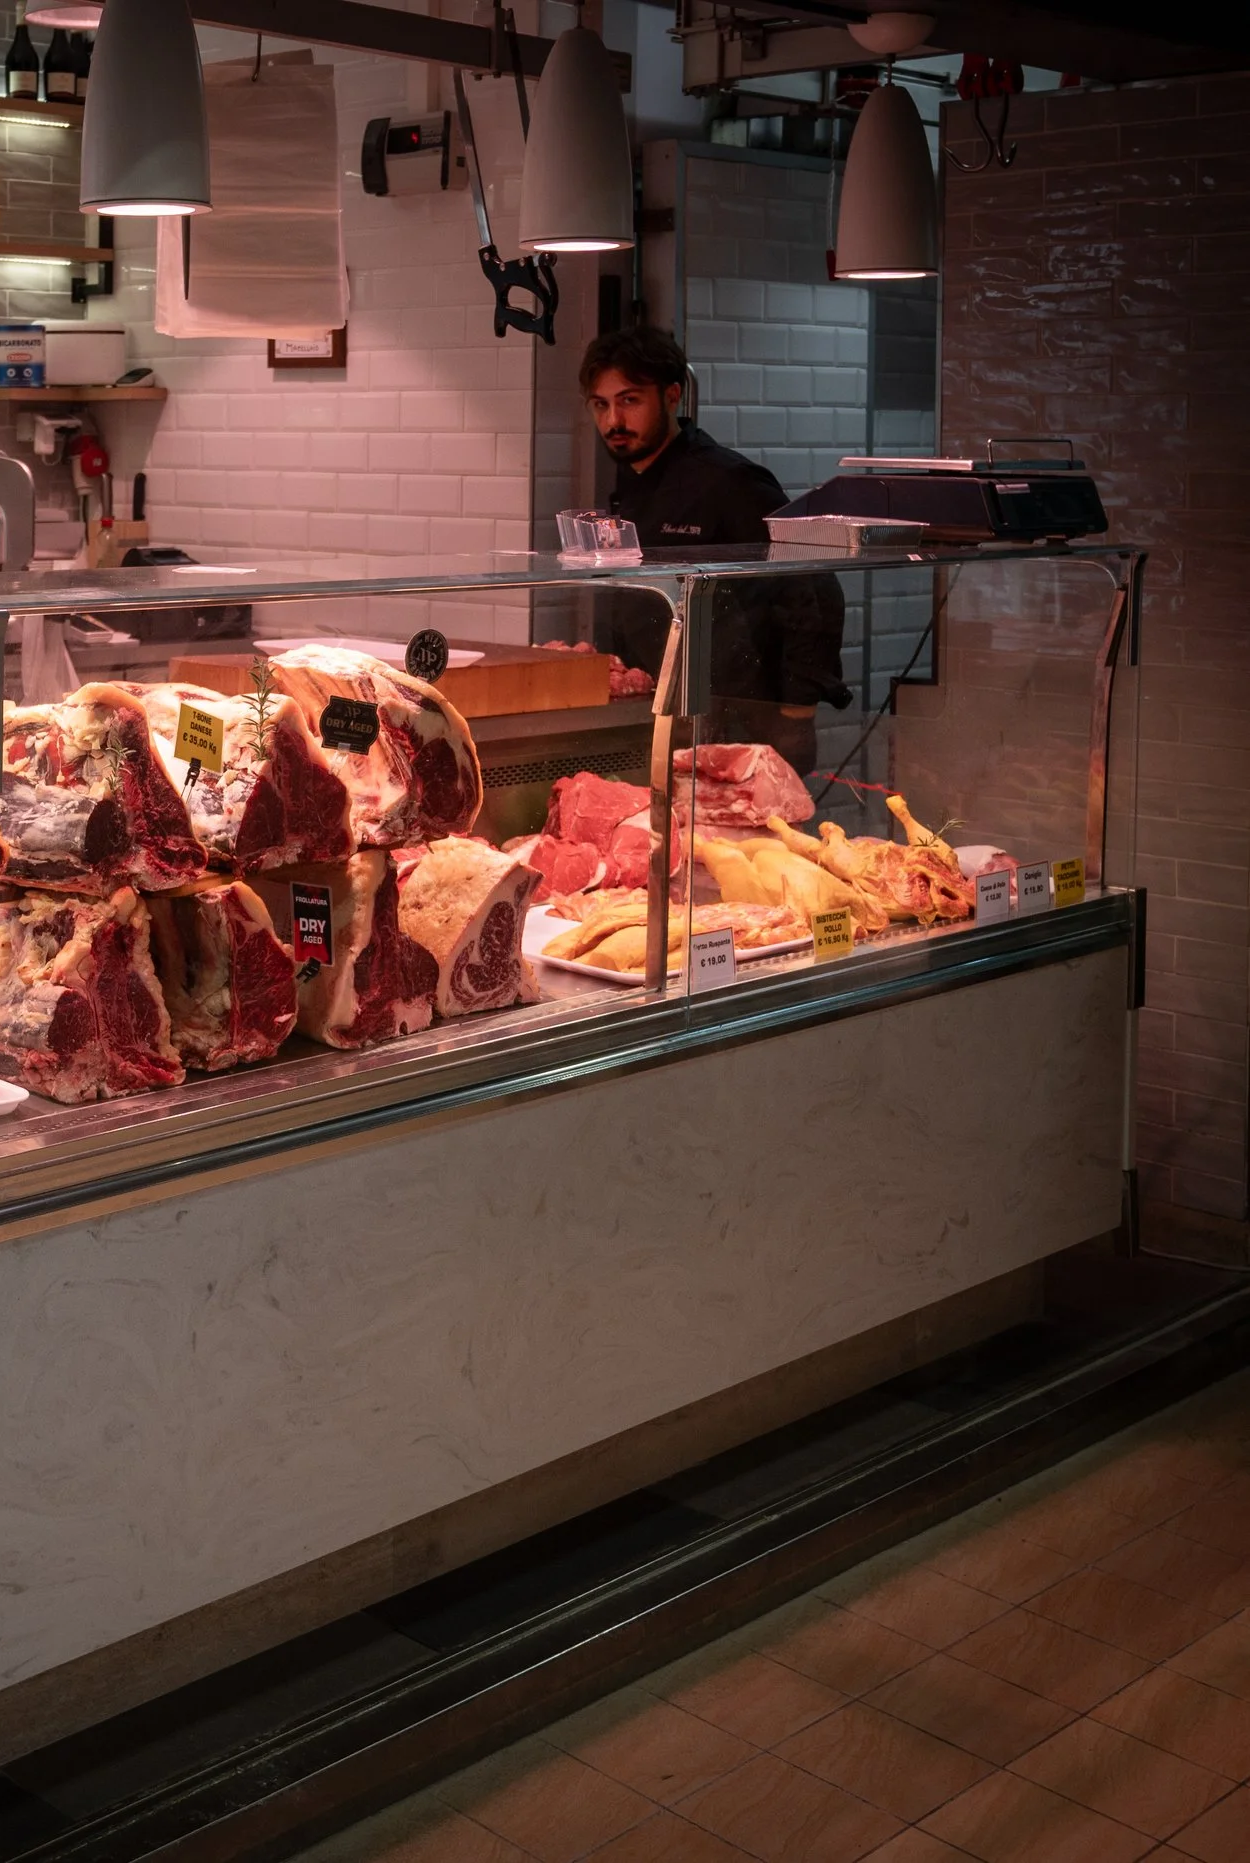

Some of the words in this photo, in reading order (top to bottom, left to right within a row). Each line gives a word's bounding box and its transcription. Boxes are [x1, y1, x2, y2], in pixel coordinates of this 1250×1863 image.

[193, 711, 212, 725] T-BONE
[190, 722, 212, 737] DANESE
[326, 717, 347, 728] DRY
[348, 719, 374, 734] AGED
[182, 732, 188, 741] €
[189, 735, 208, 749] 35,00
[209, 742, 217, 755] Kg
[295, 896, 328, 906] FROLLATURA
[816, 911, 847, 924] BISTECCHE
[299, 917, 326, 933] DRY
[824, 923, 842, 933] POLLO
[303, 935, 323, 945] AGED
[701, 959, 706, 968] €
